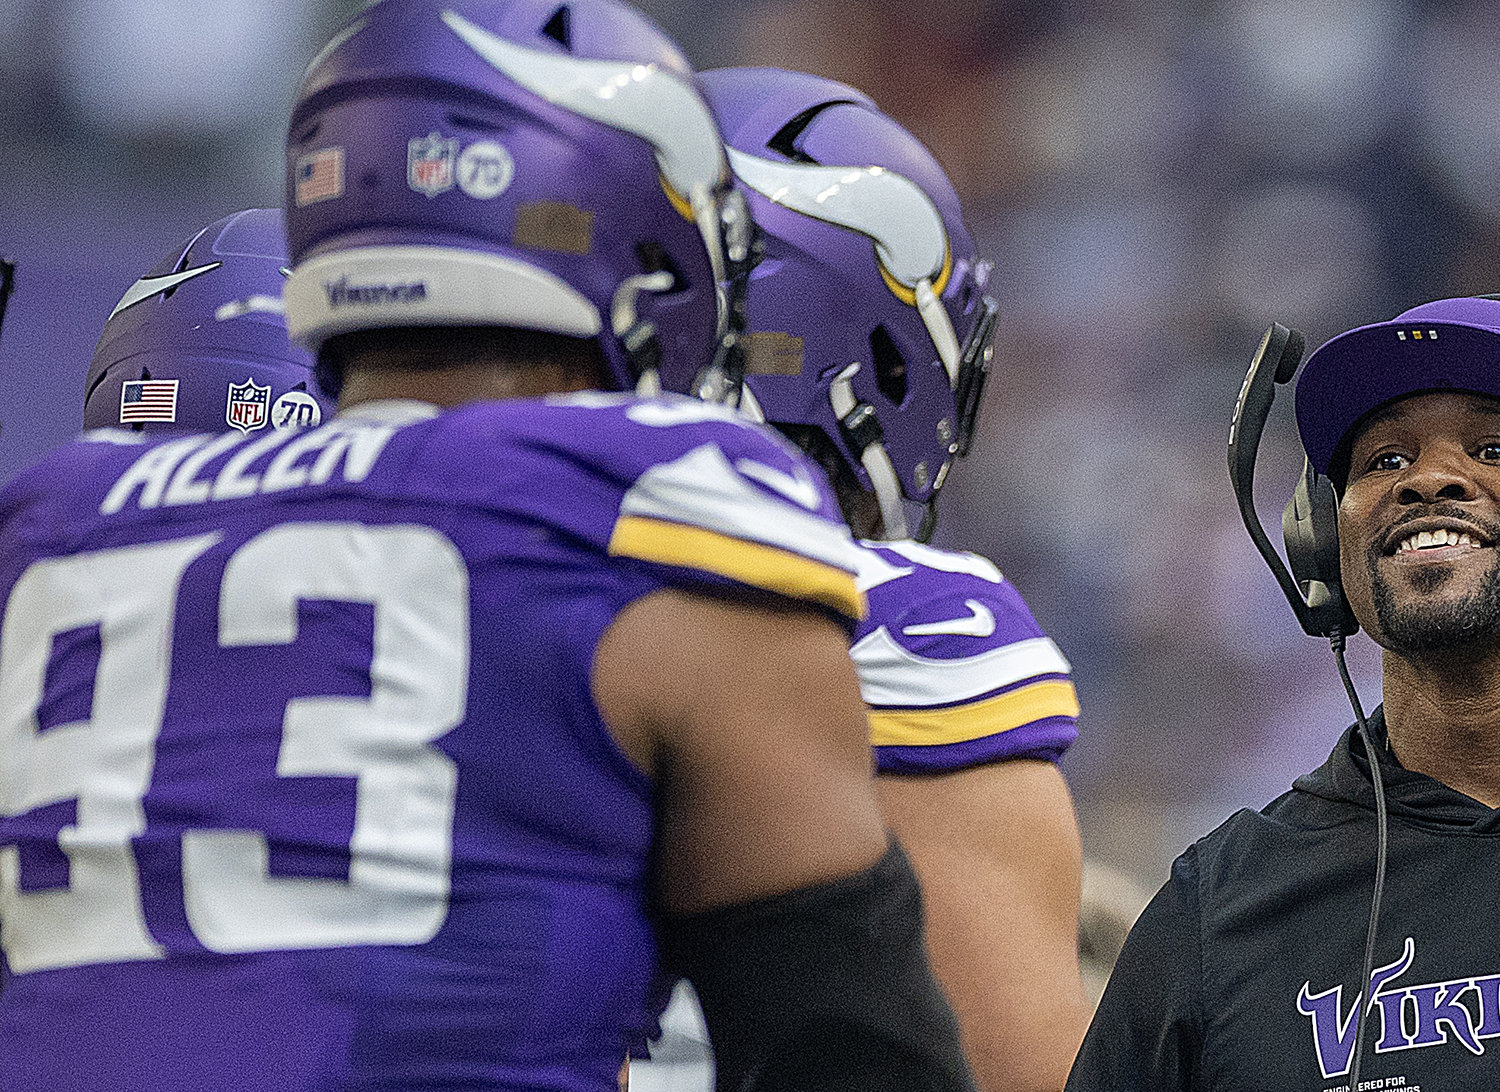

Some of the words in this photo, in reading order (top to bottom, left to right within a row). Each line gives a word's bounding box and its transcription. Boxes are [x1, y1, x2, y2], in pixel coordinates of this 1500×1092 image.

[232, 403, 263, 424] NFL
[100, 424, 398, 515] ALLEN
[0, 521, 470, 975] 93
[1385, 1076, 1406, 1087] FOR
